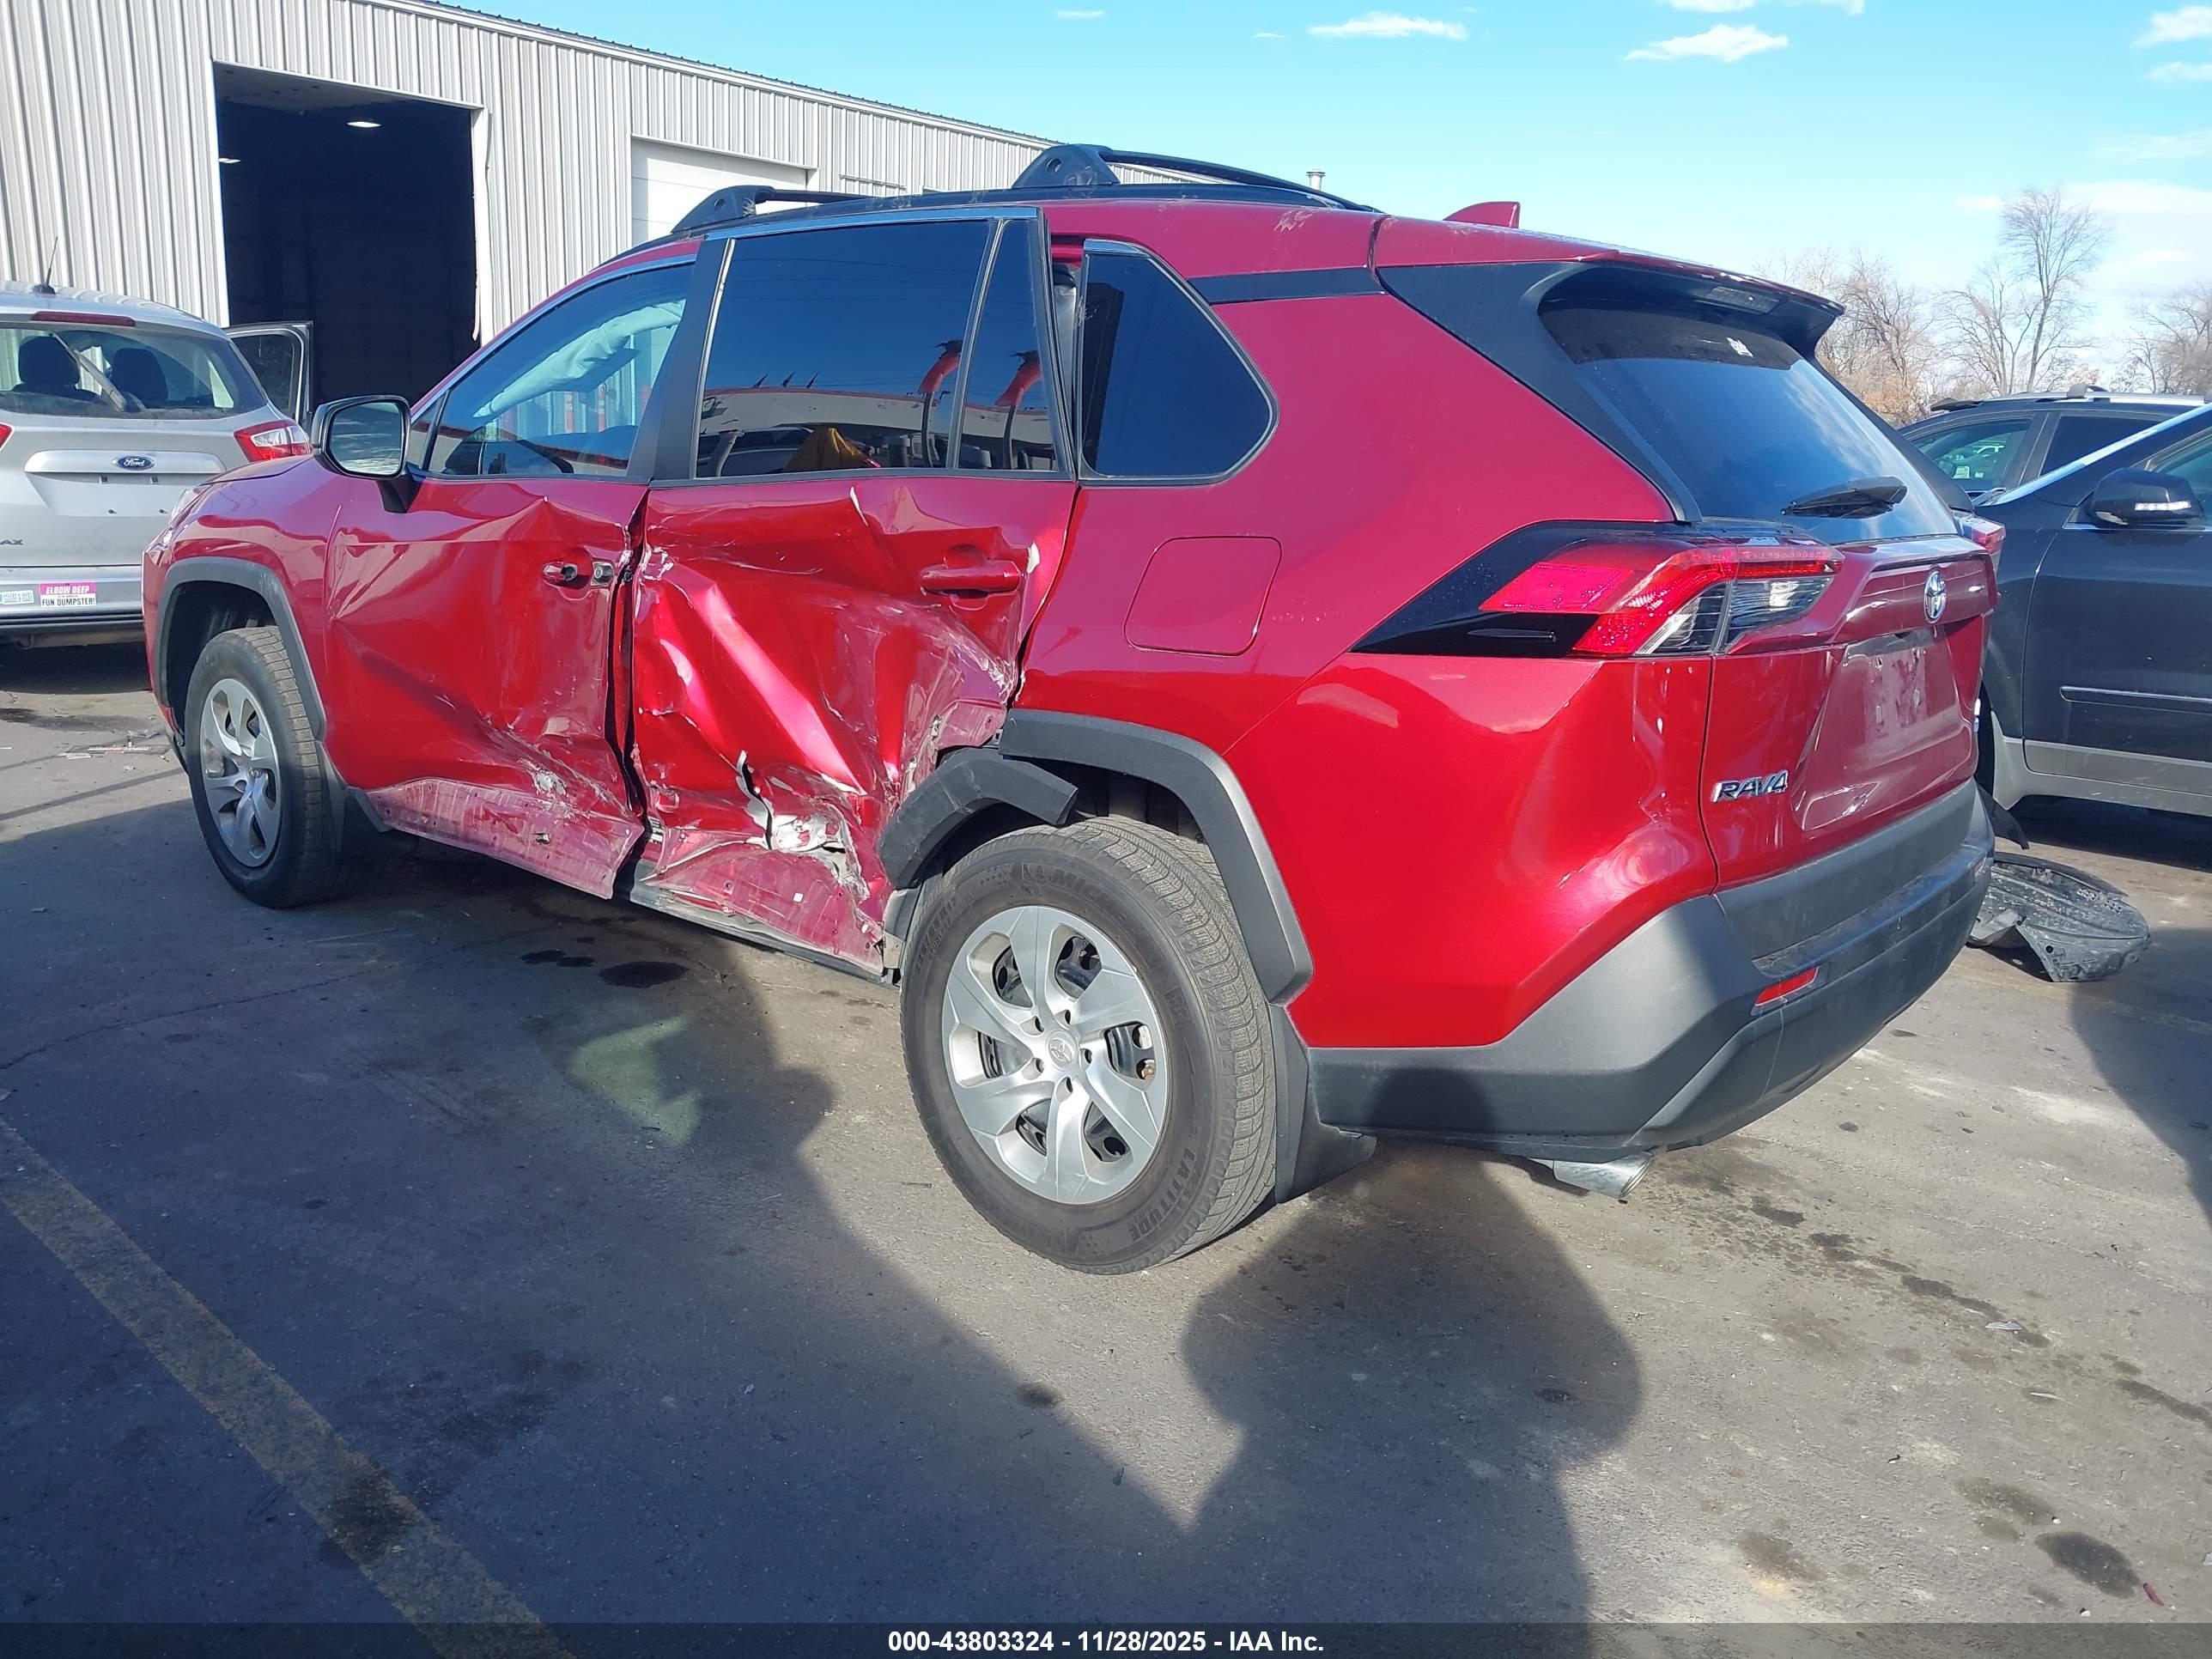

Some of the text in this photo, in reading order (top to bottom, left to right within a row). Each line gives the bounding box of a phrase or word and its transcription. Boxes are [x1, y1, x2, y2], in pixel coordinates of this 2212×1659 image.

[123, 457, 146, 467] Ford
[57, 597, 95, 606] DUMPSTER!
[1711, 769, 1789, 803] RAV4
[1127, 1147, 1196, 1242] LATITUDE
